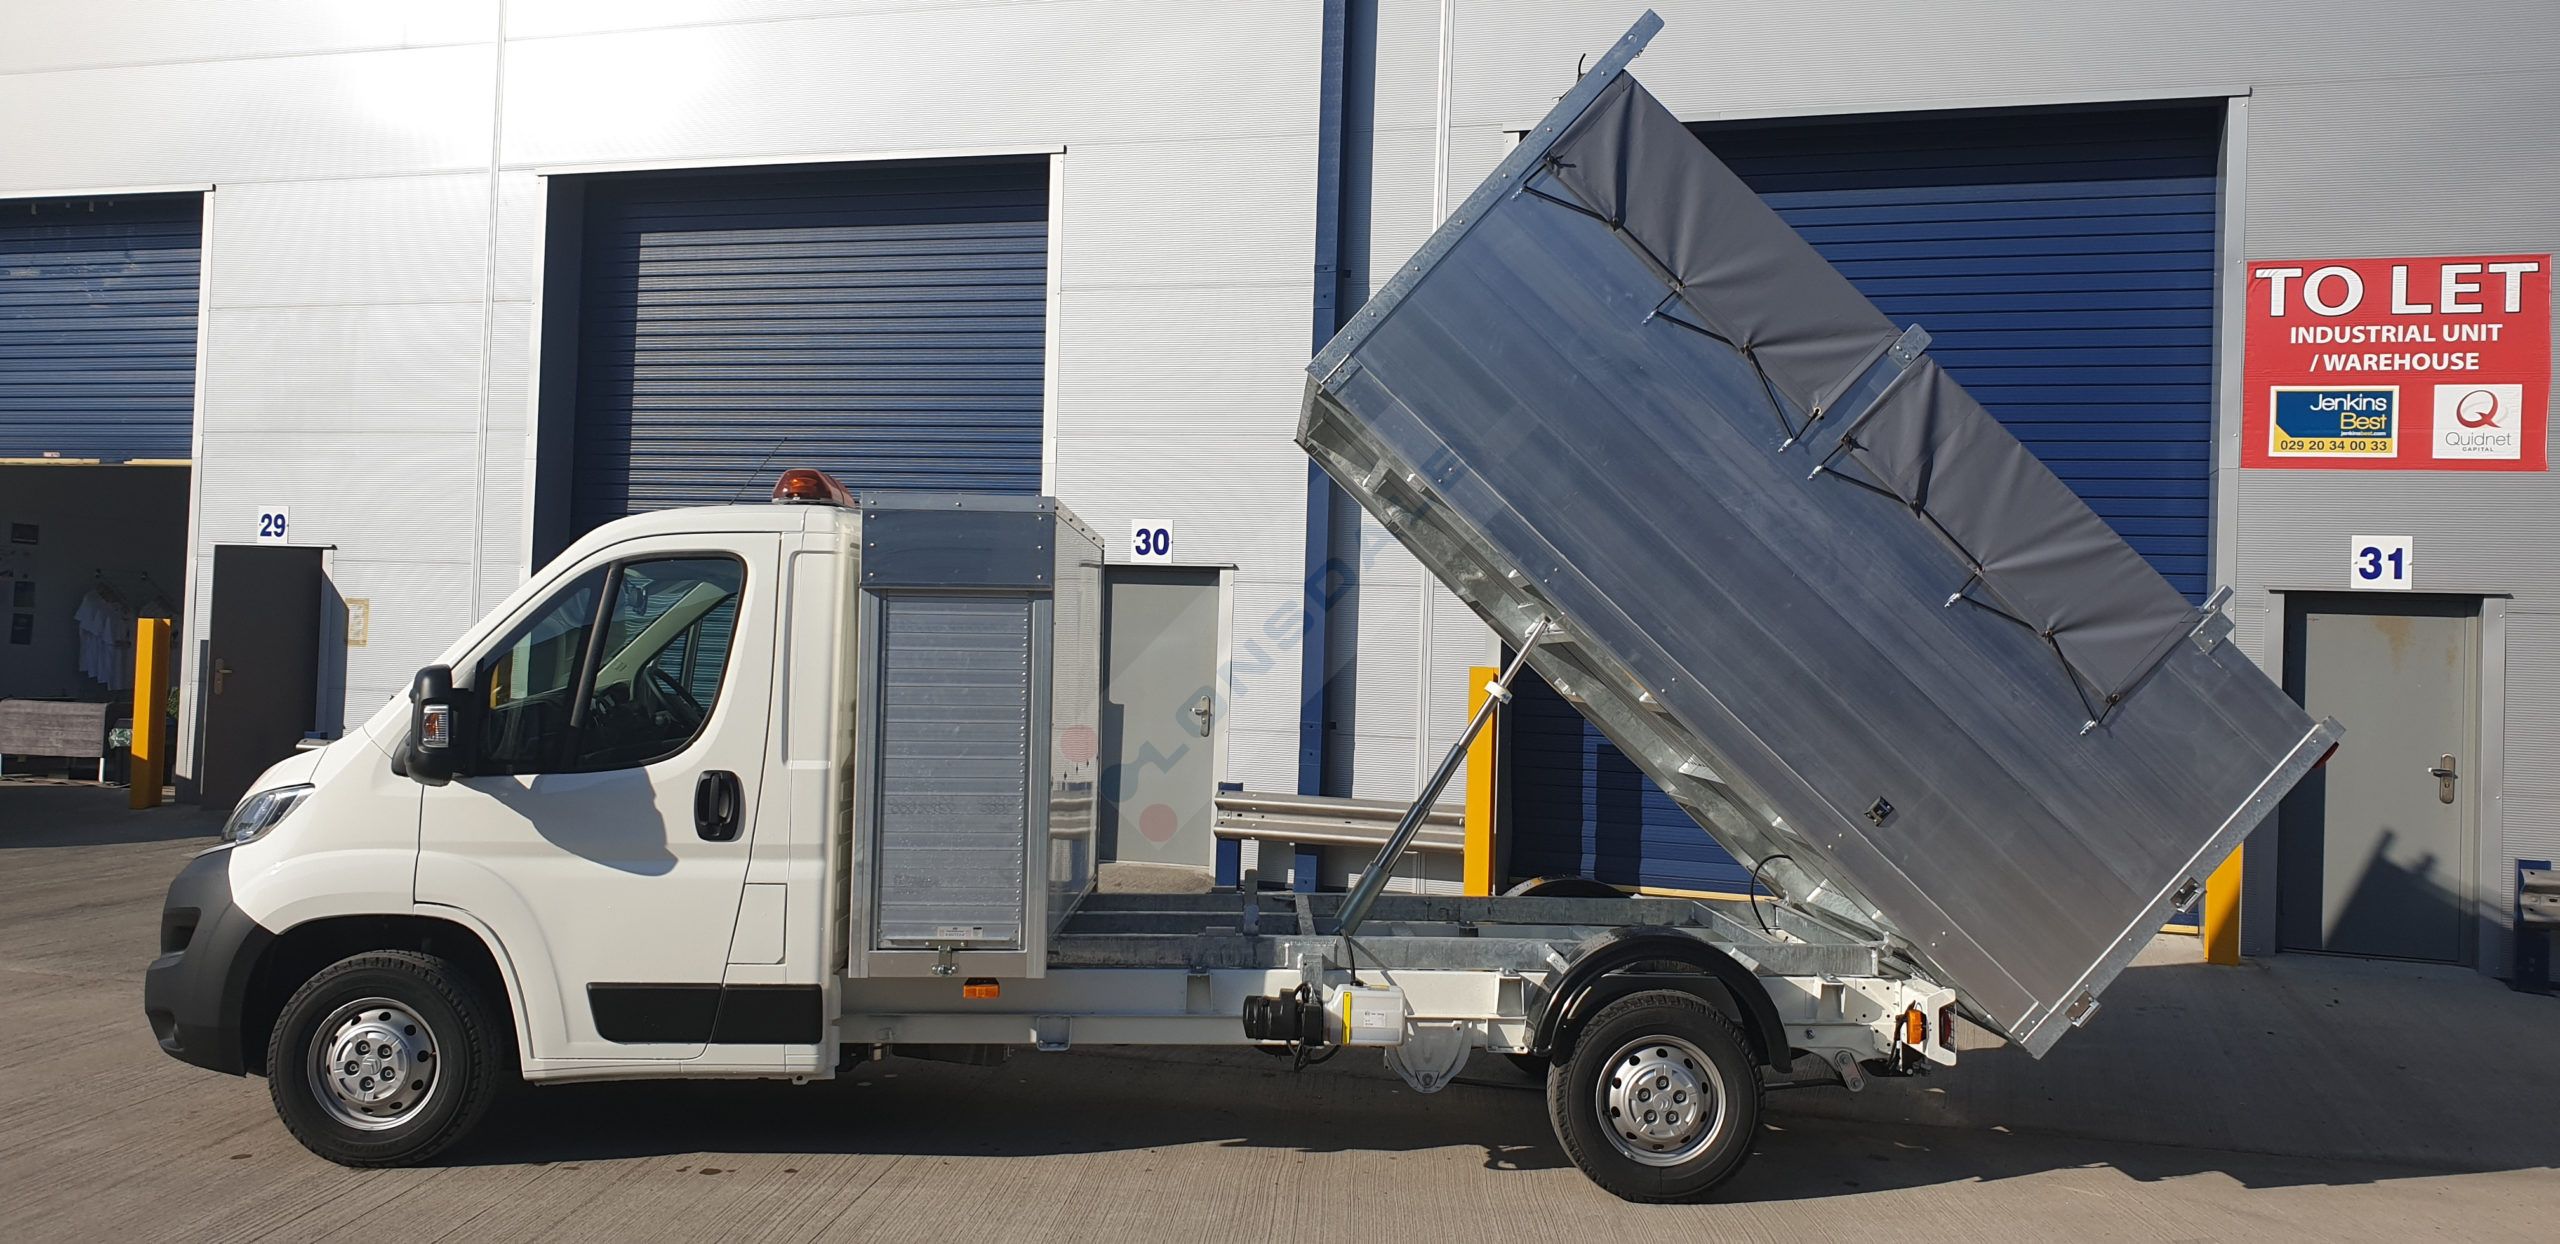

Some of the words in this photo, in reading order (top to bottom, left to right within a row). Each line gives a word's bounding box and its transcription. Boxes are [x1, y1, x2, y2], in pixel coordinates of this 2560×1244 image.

[2255, 264, 2365, 318] TO
[2390, 261, 2541, 315] LET
[2289, 324, 2437, 345] INDUSTRIAL
[2442, 323, 2504, 343] UNIT
[2309, 393, 2388, 411] Jenkins
[2340, 411, 2388, 430] Best
[2280, 440, 2305, 451] 029
[2308, 440, 2325, 451] 20
[2329, 440, 2345, 451] 34
[2350, 440, 2367, 451] 00
[2370, 440, 2388, 451] 33
[2445, 431, 2512, 446] Quidnet
[260, 513, 286, 538] 29
[1134, 528, 1170, 556] 30
[2358, 546, 2403, 580] 31
